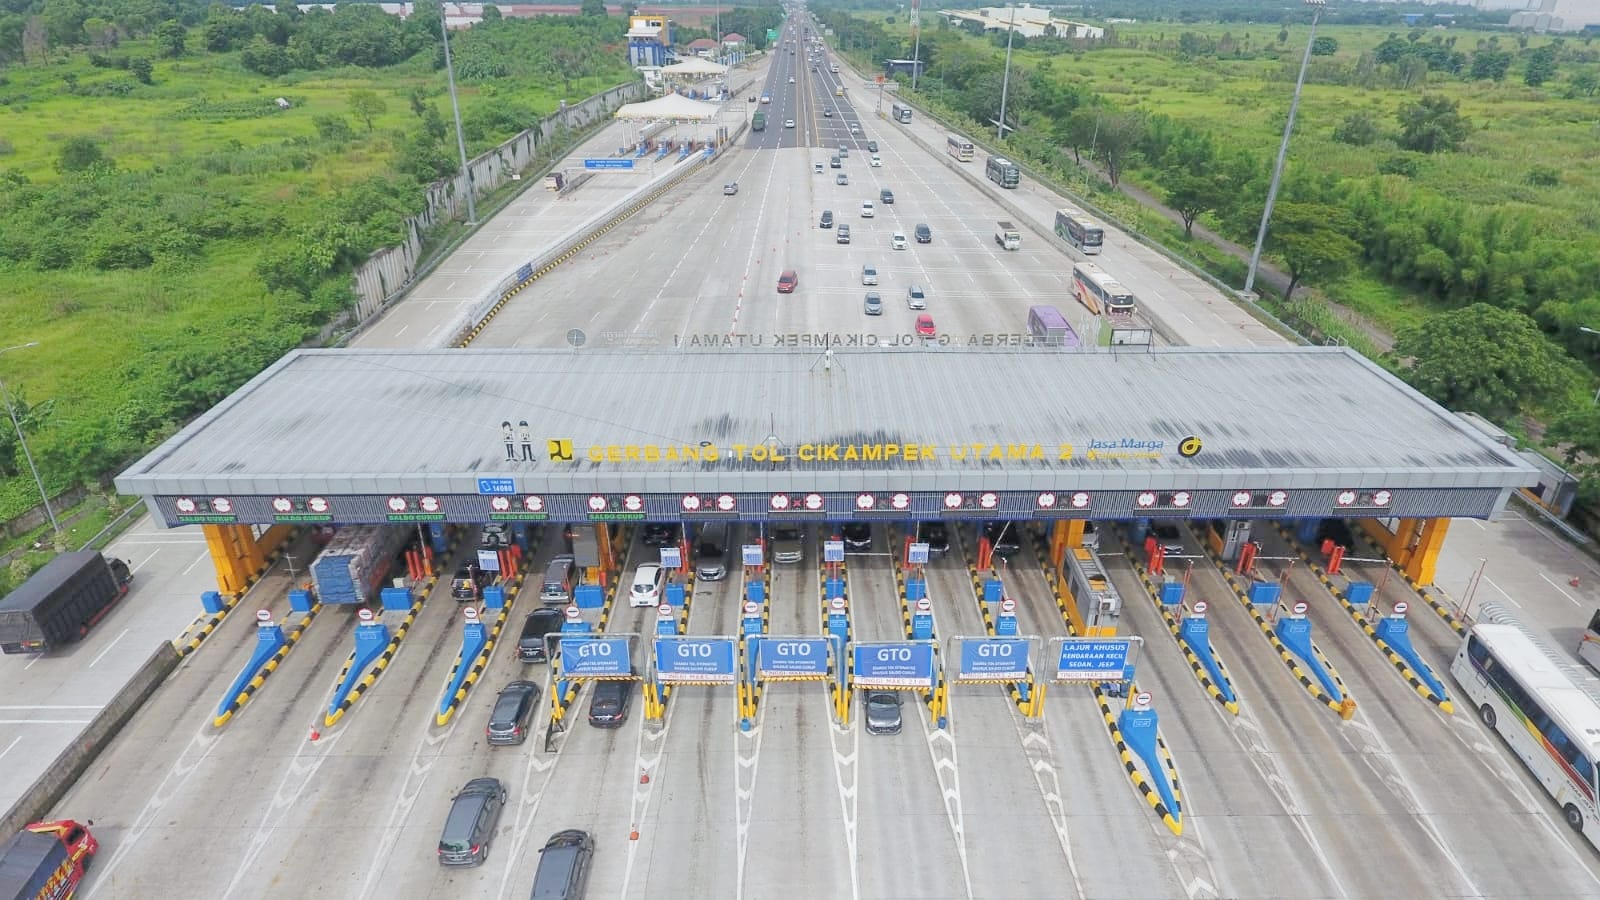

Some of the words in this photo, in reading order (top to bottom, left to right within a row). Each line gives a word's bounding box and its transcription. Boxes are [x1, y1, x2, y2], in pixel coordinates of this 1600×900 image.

[1088, 438, 1116, 449] Jasa
[1121, 438, 1164, 451] Marga
[588, 443, 720, 463] GERBANG
[732, 443, 785, 462] TOL
[798, 443, 936, 461] CIKAMPEK
[951, 443, 1044, 460] UTAMA
[1058, 443, 1073, 460] 2
[579, 643, 611, 657] GTO
[677, 643, 712, 657] GTO
[777, 643, 811, 656] GTO
[877, 648, 912, 661] GTO
[978, 643, 1012, 657] GTO
